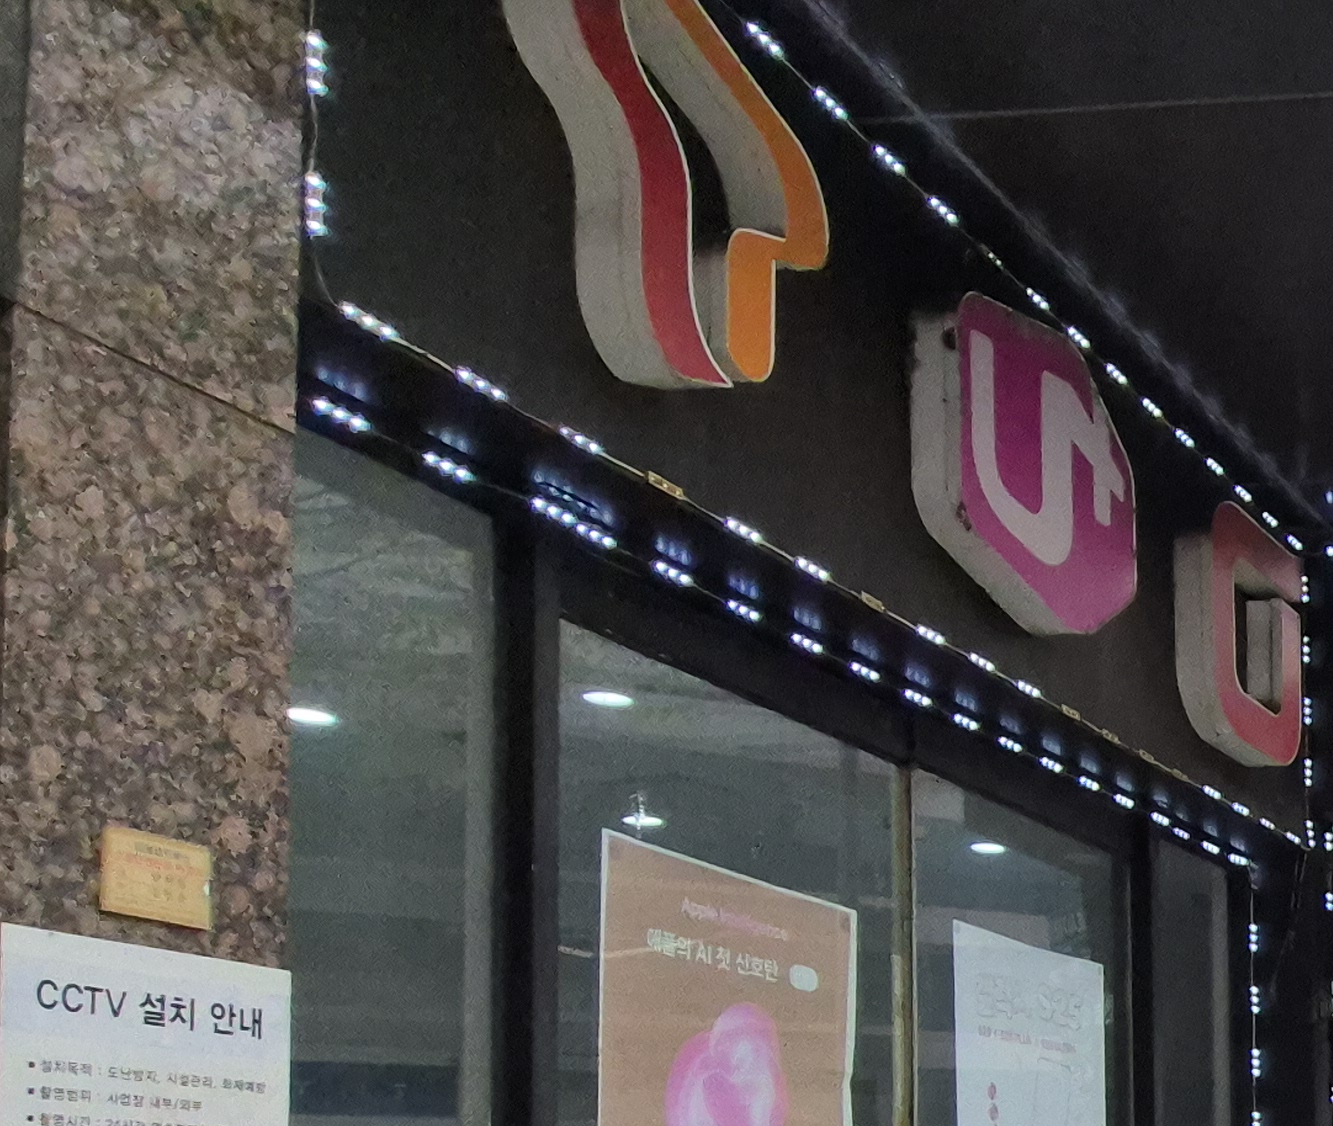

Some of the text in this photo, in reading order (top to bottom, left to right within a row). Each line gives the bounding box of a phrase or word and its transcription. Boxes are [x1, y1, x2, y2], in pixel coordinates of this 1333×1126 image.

[646, 927, 779, 983] 애플의 AI 첫 신호탄
[36, 978, 264, 1041] CCTV 설치 안내
